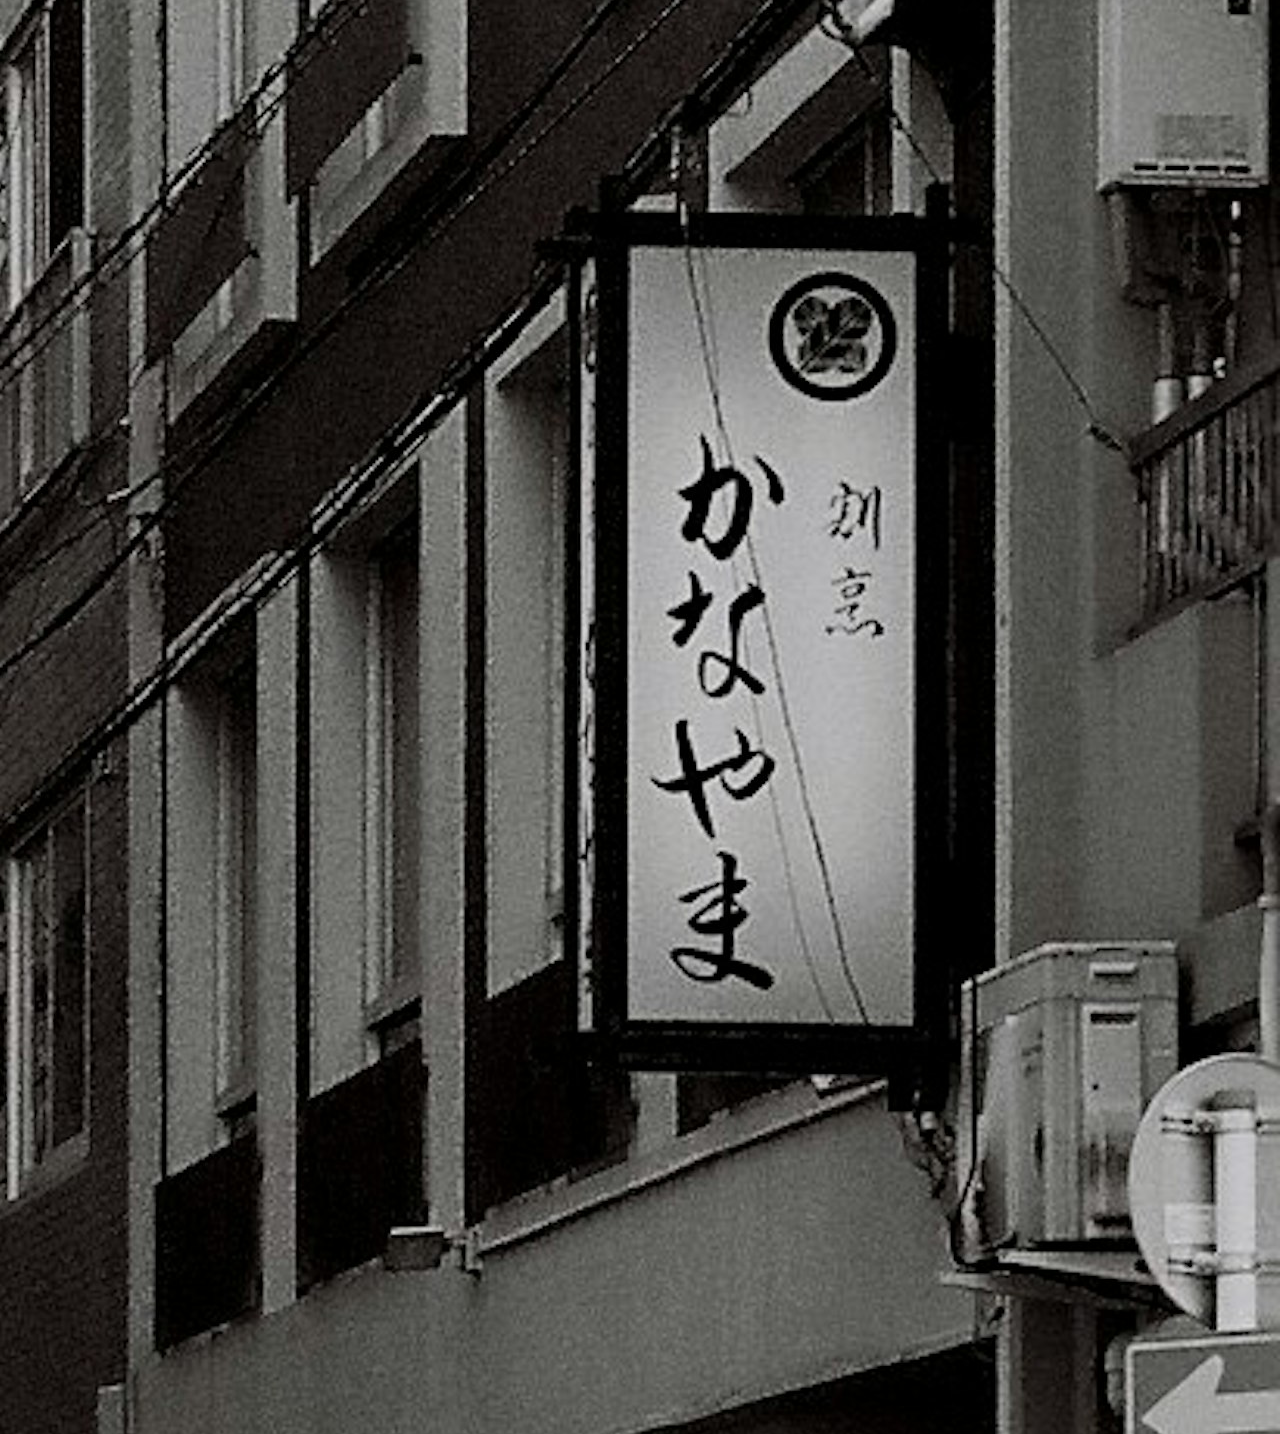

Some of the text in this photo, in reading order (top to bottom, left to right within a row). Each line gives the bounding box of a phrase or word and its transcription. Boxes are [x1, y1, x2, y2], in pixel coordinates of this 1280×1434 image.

[650, 433, 785, 991] かなやま
[825, 481, 886, 640] 割烹
